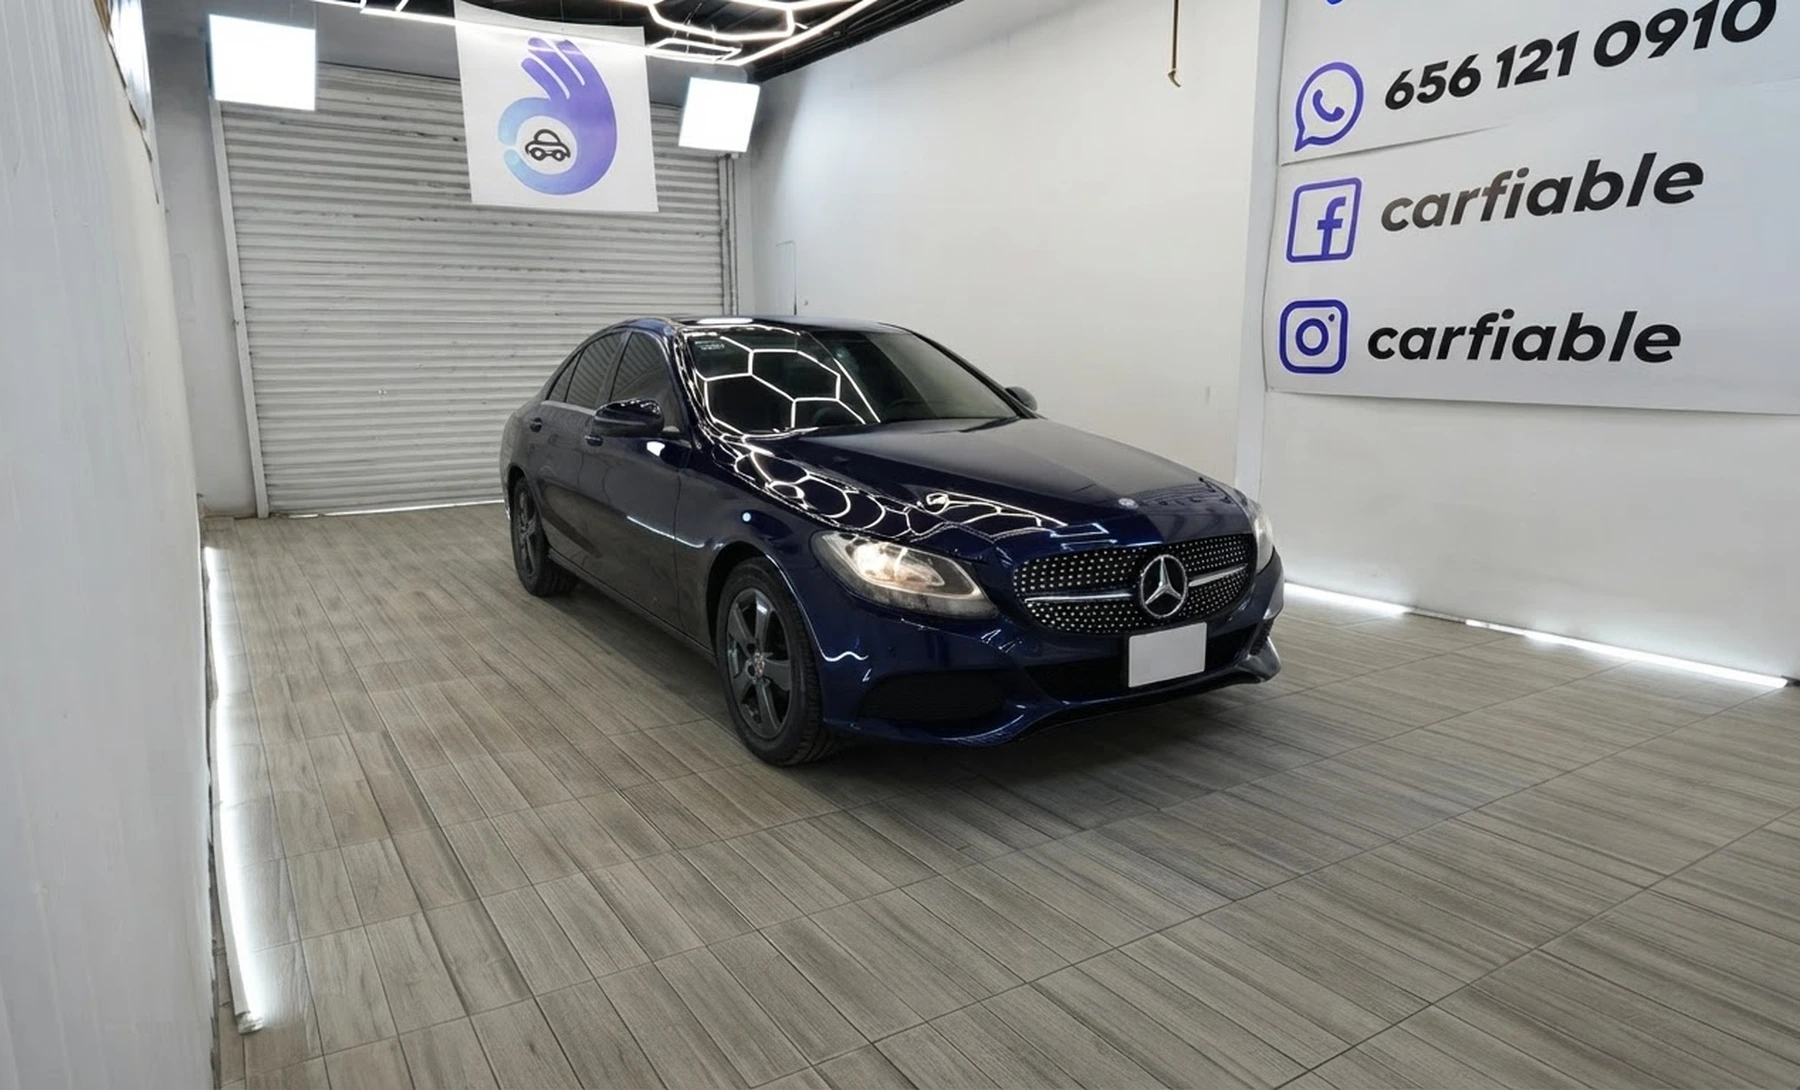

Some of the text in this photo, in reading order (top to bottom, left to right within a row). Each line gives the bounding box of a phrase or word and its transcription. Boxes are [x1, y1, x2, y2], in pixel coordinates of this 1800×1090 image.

[1384, 0, 1778, 111] 656 121 0910
[1381, 151, 1704, 232] carfiable
[1367, 308, 1682, 364] carfiable
